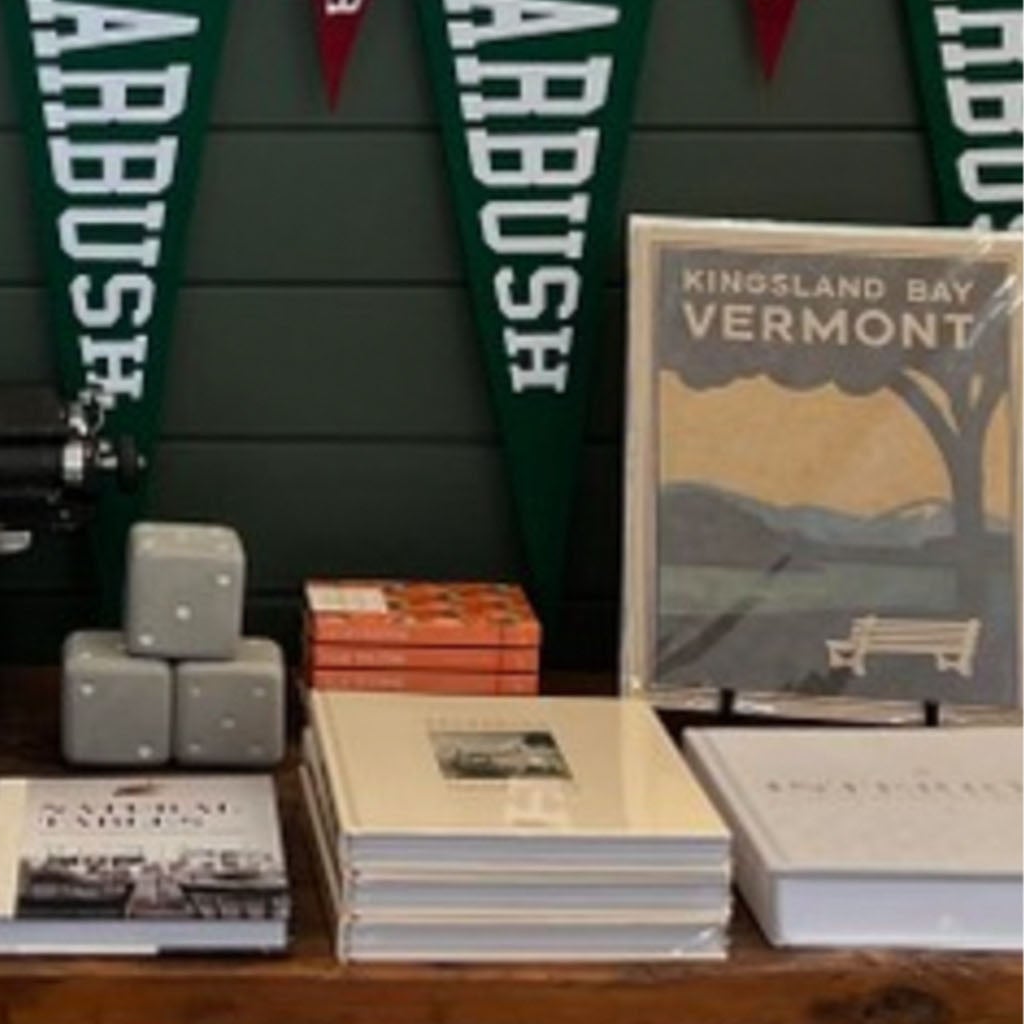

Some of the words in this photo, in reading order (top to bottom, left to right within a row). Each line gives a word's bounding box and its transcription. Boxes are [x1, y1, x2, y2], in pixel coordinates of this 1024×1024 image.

[682, 268, 886, 299] KINGSLAND
[906, 278, 974, 305] BAY
[682, 302, 975, 350] VERMONT
